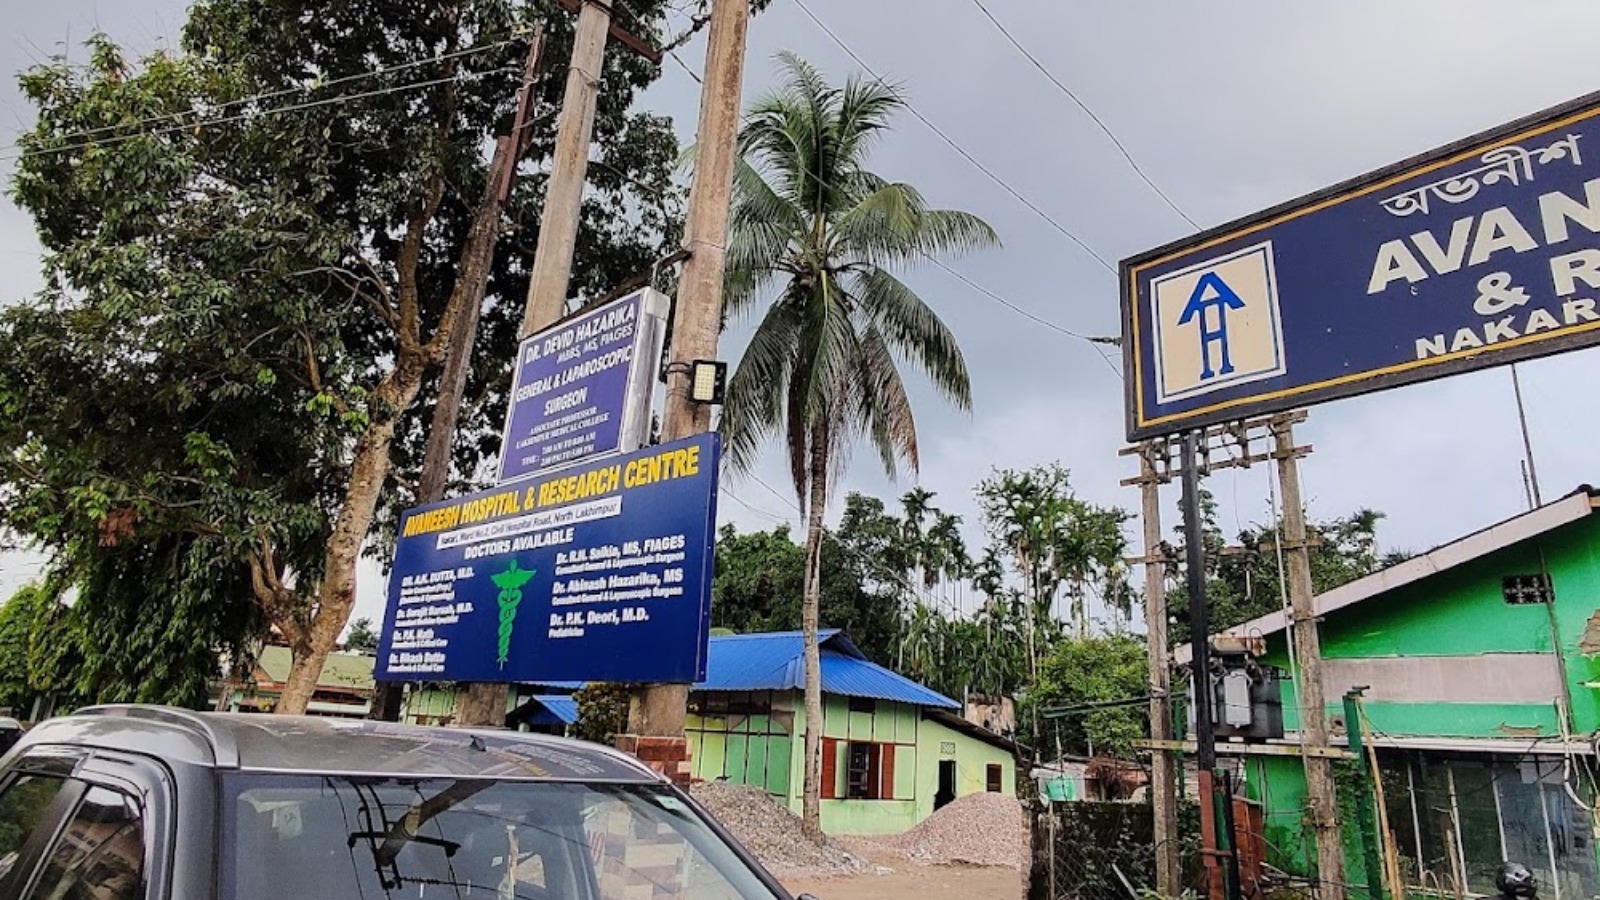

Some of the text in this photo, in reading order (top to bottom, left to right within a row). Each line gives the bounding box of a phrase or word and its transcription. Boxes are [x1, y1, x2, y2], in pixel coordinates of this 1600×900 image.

[1473, 271, 1531, 316] &
[525, 303, 635, 364] DR. DEVID HAZARIKA
[600, 322, 633, 346] FIAGES
[516, 345, 632, 402] GENERAL & LAPAROSCOPIC
[544, 387, 588, 416] SURGEON
[578, 412, 610, 429] COLLEGE
[403, 445, 700, 538] AVANEESH HOSPITAL & RESEARCH CENTRE
[554, 512, 574, 524] North
[575, 503, 618, 520] Lakhimpur
[464, 528, 574, 560] DOCTORS AVAILABLE
[556, 552, 568, 564] Dr.
[622, 542, 641, 556] MS,
[644, 534, 685, 552] FIAGES
[552, 568, 683, 594] Dr. Abinash Hazarika, MS
[550, 607, 650, 626] Dr. P.K. Deori, M.D.
